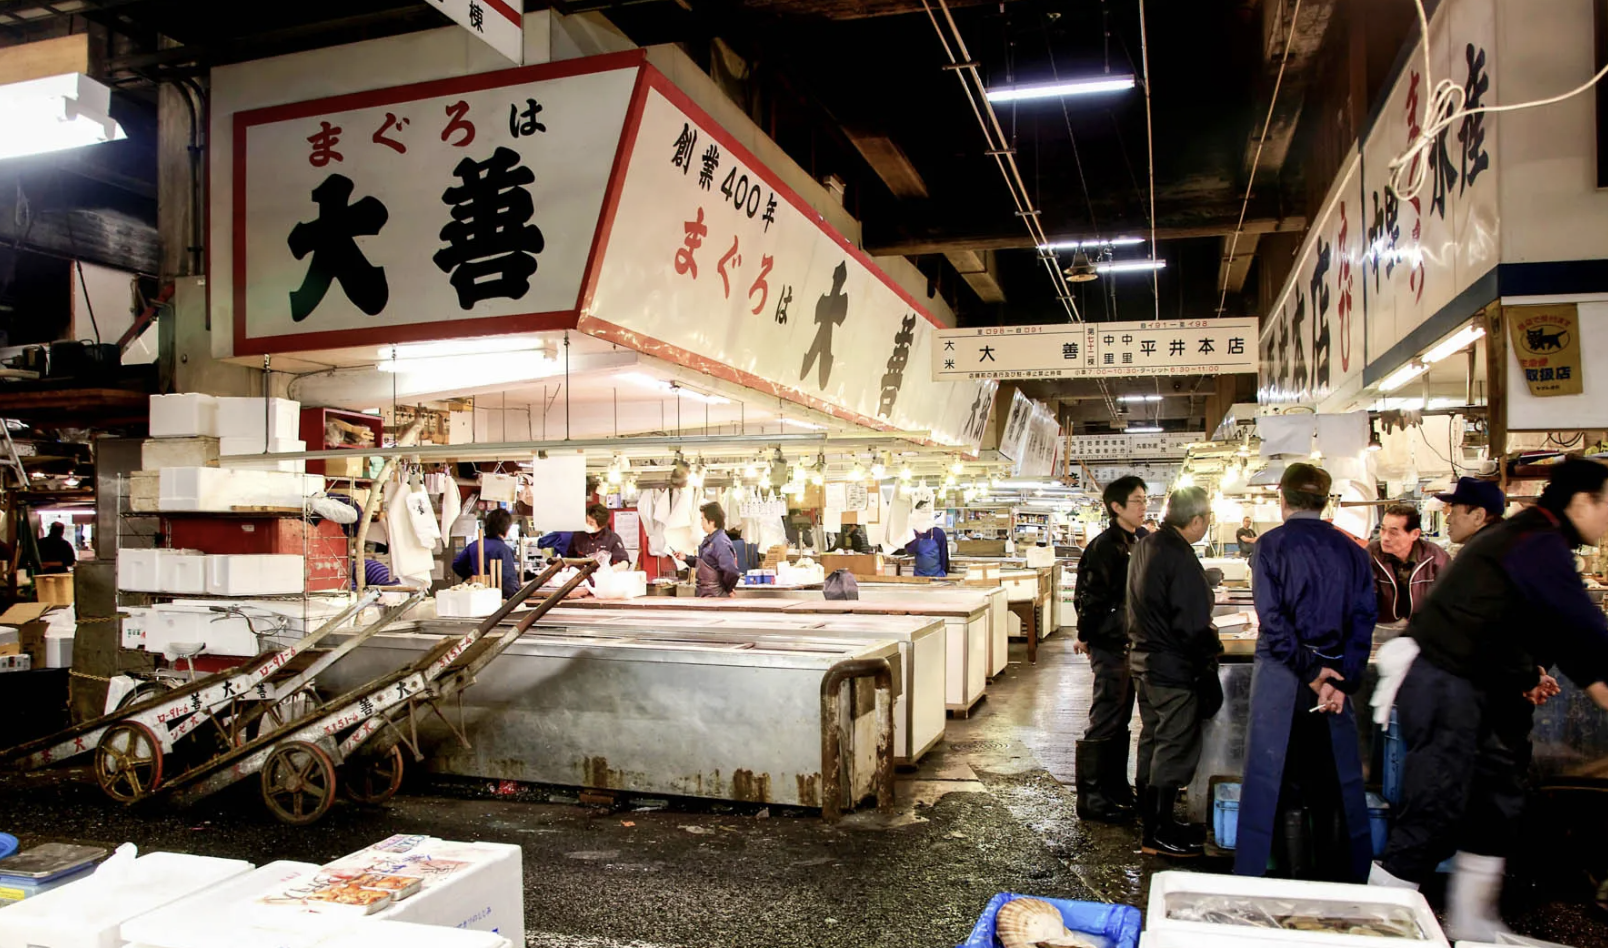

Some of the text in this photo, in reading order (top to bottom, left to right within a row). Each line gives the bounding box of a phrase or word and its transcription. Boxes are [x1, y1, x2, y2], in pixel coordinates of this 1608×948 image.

[306, 98, 546, 168] まぐろは
[672, 122, 777, 233] 創業400年
[287, 146, 545, 322] 大善
[1140, 337, 1245, 357] 平井本店
[1526, 366, 1571, 382] 取扱店
